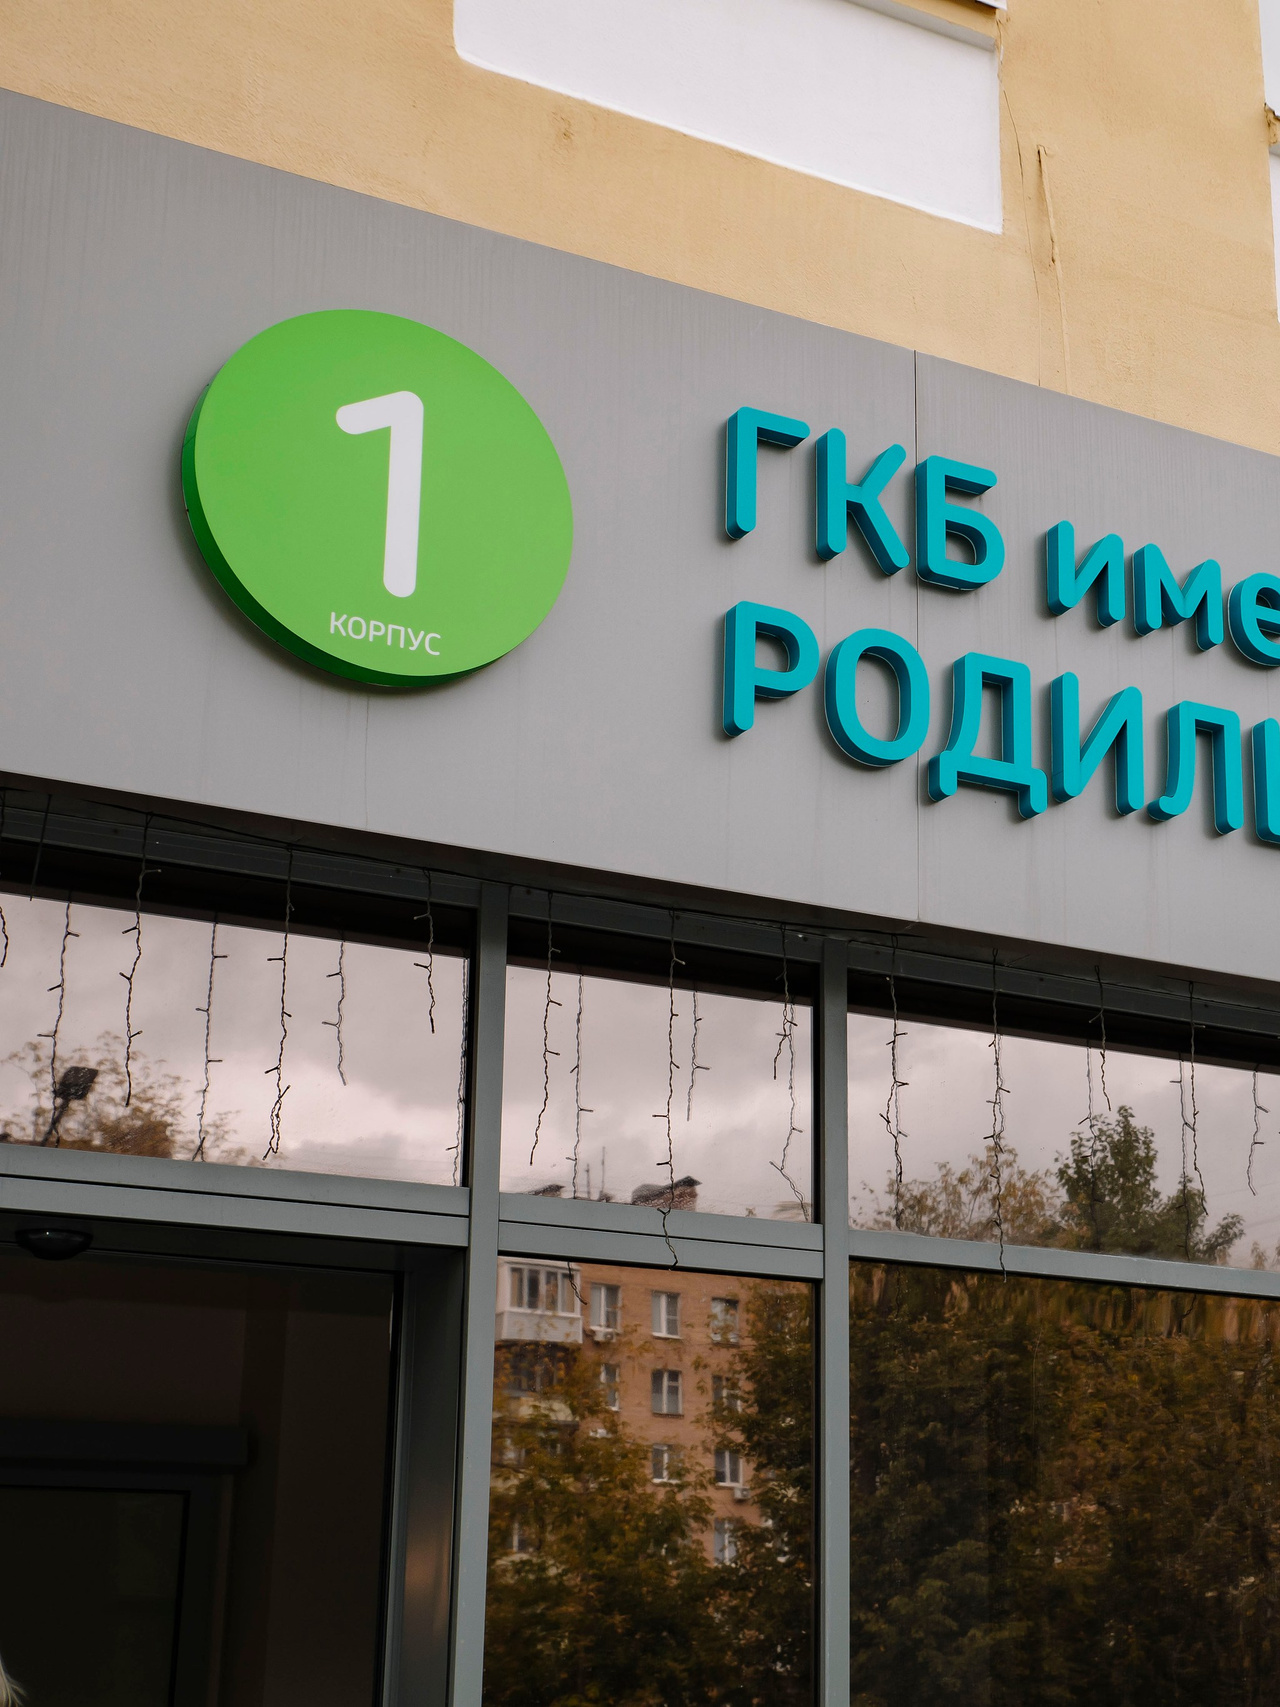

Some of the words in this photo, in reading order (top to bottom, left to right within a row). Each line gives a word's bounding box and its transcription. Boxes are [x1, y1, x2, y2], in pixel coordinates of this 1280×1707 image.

[336, 391, 424, 597] 1
[725, 405, 1006, 591] ГКБ
[329, 611, 442, 656] КОРПУС
